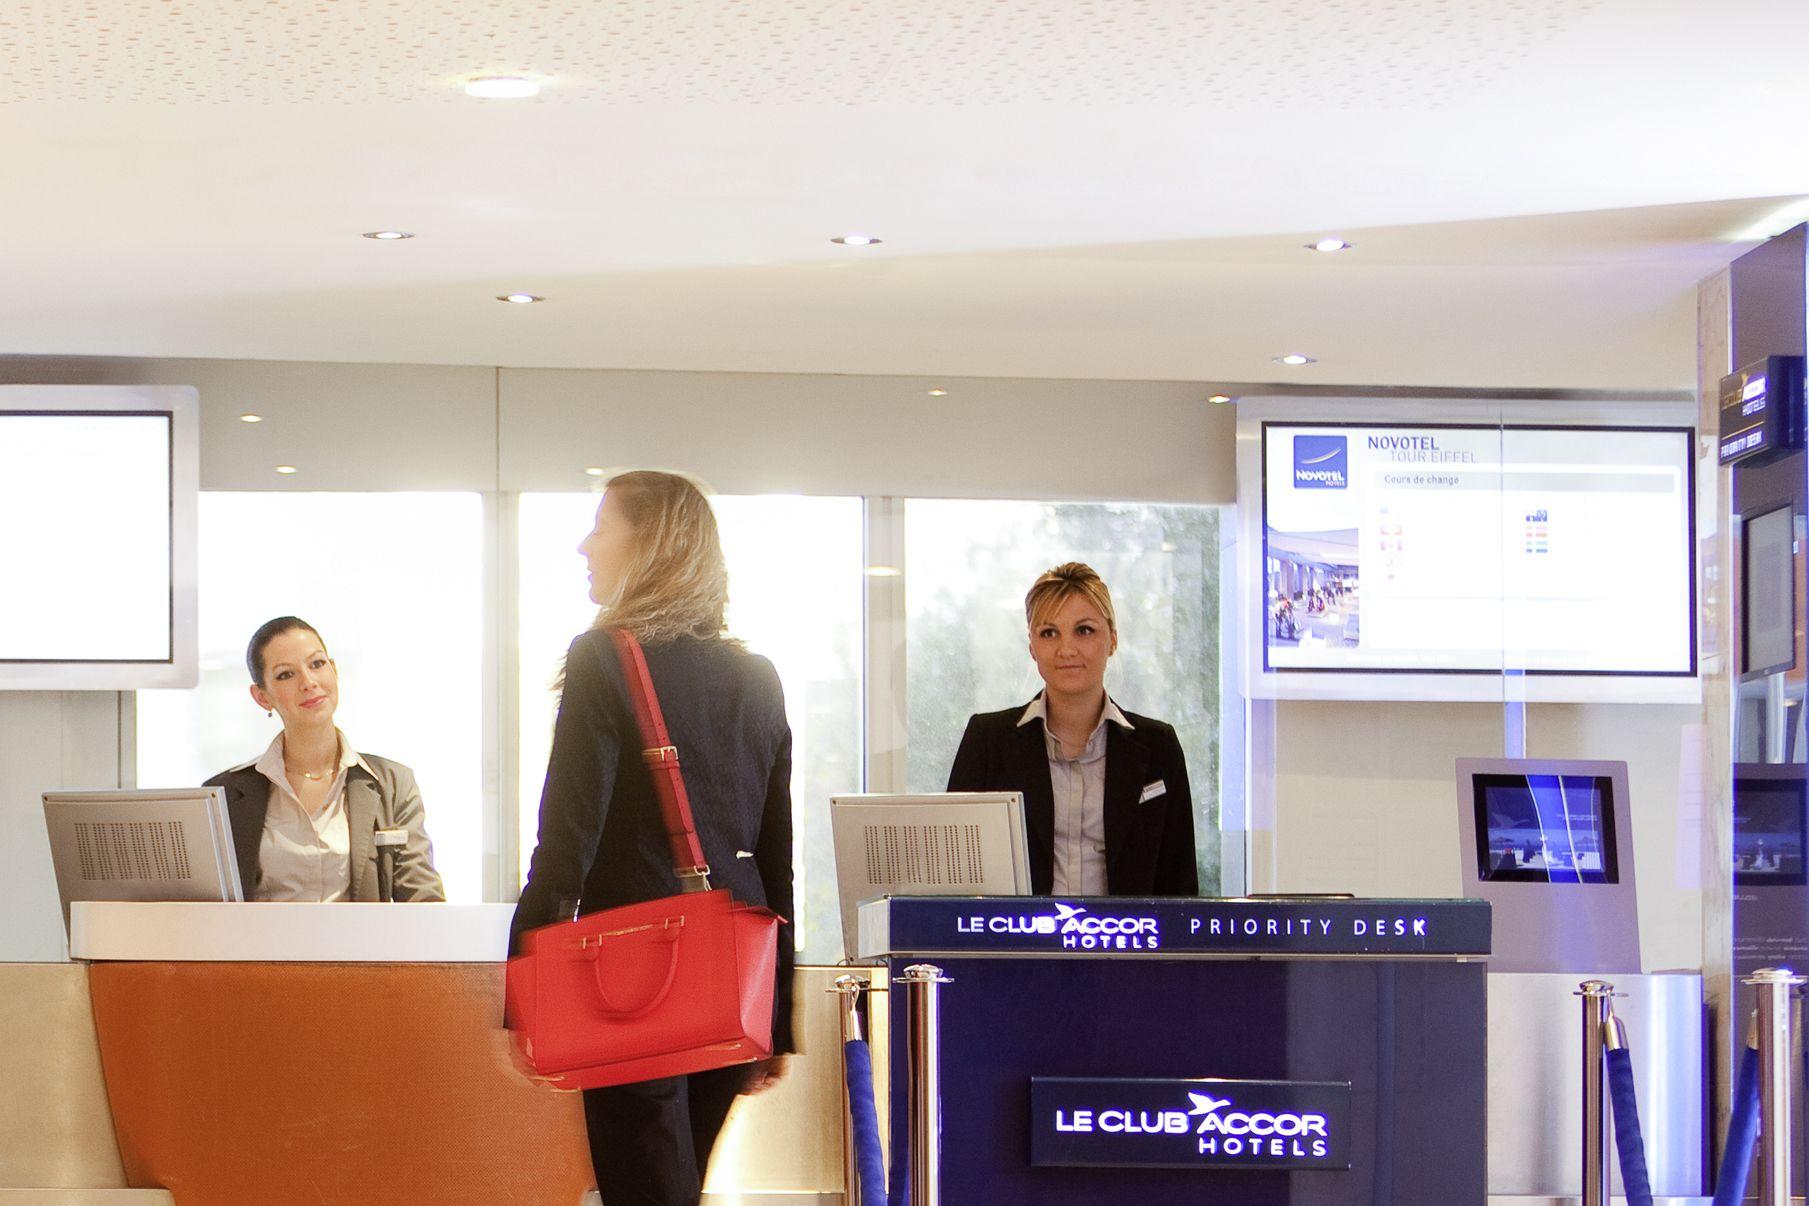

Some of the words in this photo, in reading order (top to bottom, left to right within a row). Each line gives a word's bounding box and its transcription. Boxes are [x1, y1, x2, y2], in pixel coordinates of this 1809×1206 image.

[1368, 436, 1439, 450] NOVOTEL
[1391, 451, 1426, 462] TOUR
[1432, 451, 1478, 463] EIFFEL
[1296, 469, 1344, 481] NOVOTEL
[1384, 474, 1411, 484] Cours
[1414, 474, 1424, 484] de
[1427, 474, 1459, 486] change
[958, 917, 984, 933] LE
[989, 917, 1056, 934] CLUB
[1064, 917, 1159, 935] ACCOR
[1191, 919, 1332, 936] PRIORITY
[1355, 919, 1426, 936] DESK
[1063, 936, 1159, 949] HOTELS
[1056, 1111, 1092, 1132] LE
[1098, 1111, 1190, 1134] CLUB
[1196, 1113, 1328, 1137] ACCOR
[1199, 1139, 1327, 1157] HOTELS
